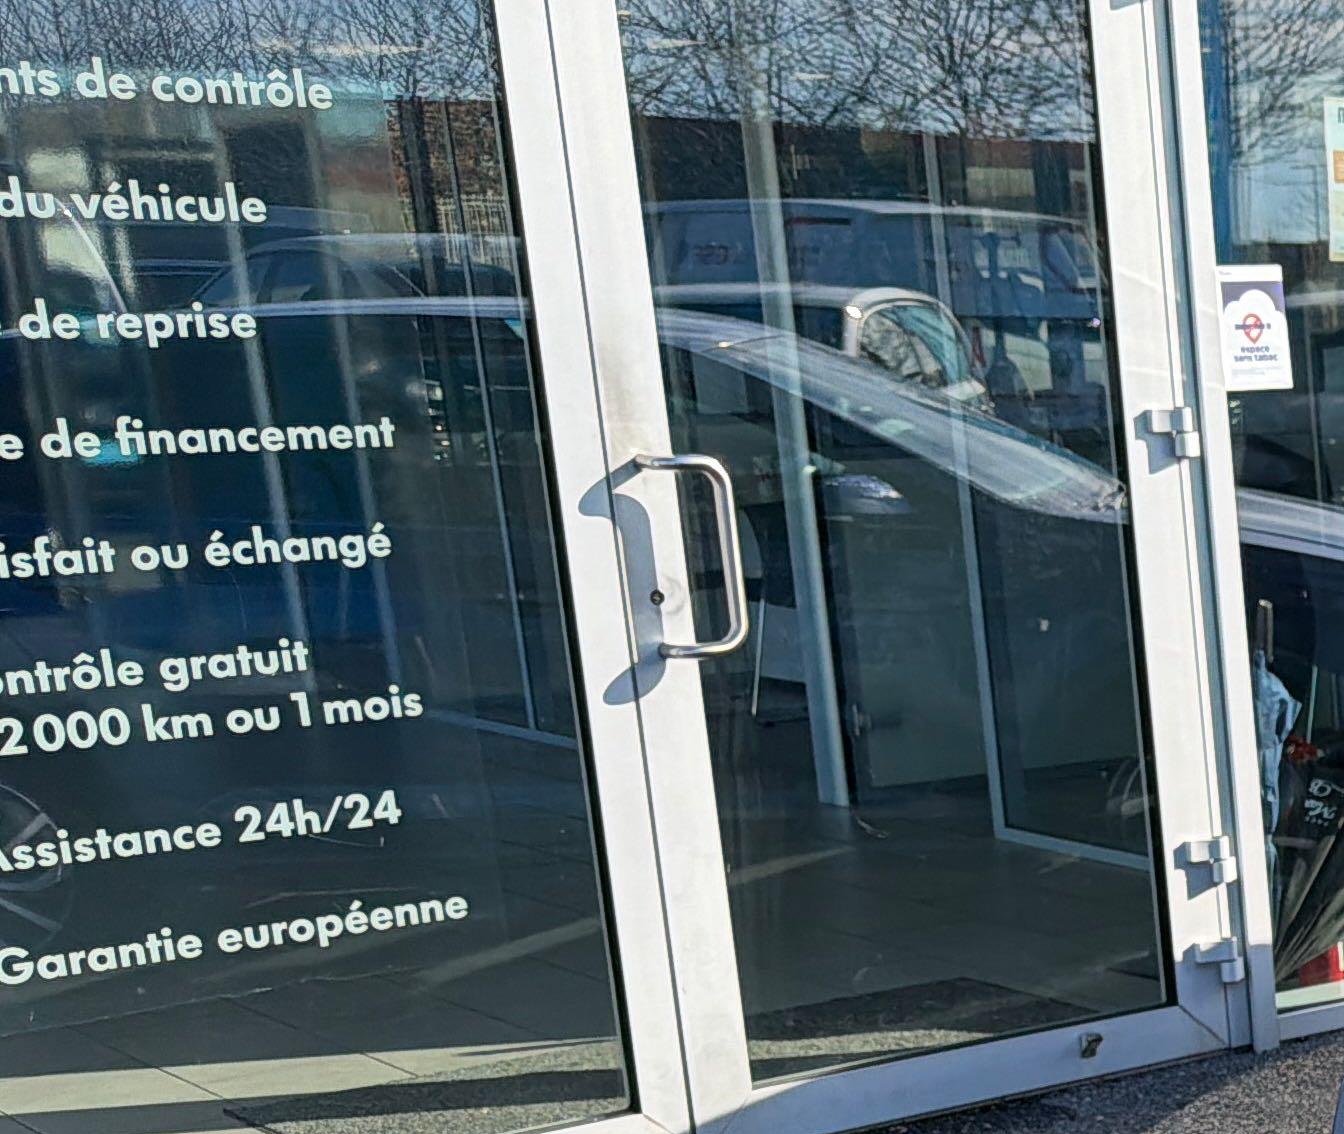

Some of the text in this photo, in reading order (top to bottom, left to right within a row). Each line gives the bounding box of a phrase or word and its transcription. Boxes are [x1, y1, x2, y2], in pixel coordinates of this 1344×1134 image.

[76, 56, 138, 100] de
[152, 68, 333, 109] contrôle
[0, 175, 267, 223] du véhicule
[20, 298, 257, 348] de reprise
[40, 417, 101, 459] de
[115, 415, 395, 456] financement
[0, 522, 391, 578] isfait ou échangé
[0, 638, 309, 696] ntrôle gratuit
[142, 703, 214, 742] km
[226, 707, 280, 733] ou
[290, 691, 311, 727] 1
[323, 684, 423, 725] mois
[234, 790, 402, 842] 24h/24
[0, 896, 468, 985] Garantie européenne
